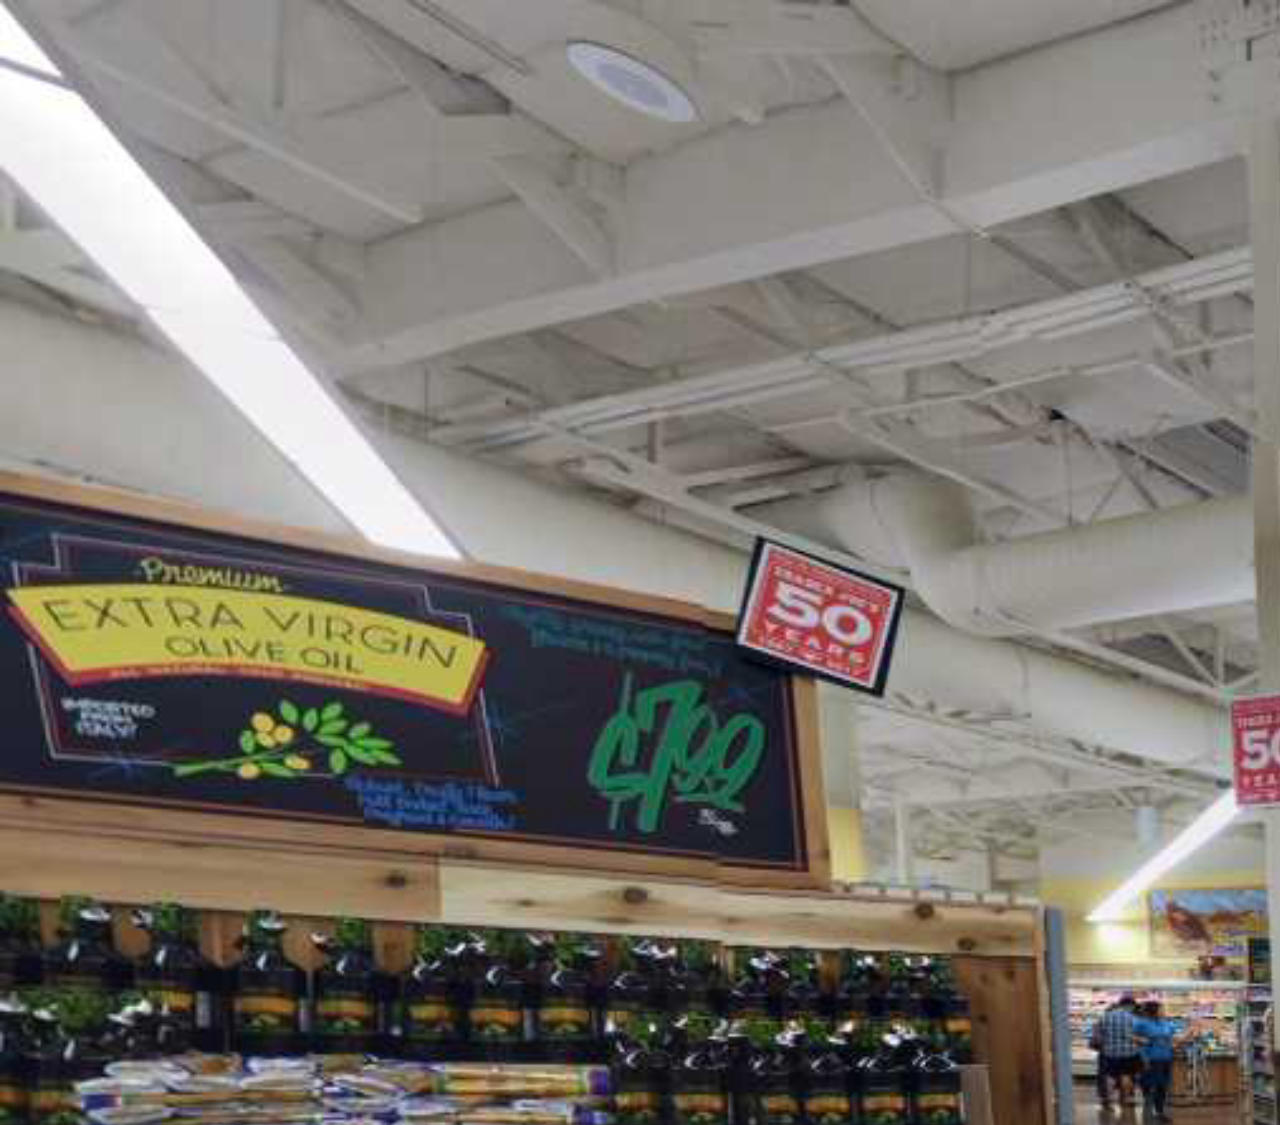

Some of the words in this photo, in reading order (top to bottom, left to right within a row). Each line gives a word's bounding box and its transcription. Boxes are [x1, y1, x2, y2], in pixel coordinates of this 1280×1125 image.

[141, 558, 283, 592] Premium
[43, 597, 244, 632] EXTRA
[264, 605, 457, 669] VIRGIN
[767, 580, 872, 646] 50
[165, 636, 285, 663] OLIVE
[301, 646, 364, 674] OIL
